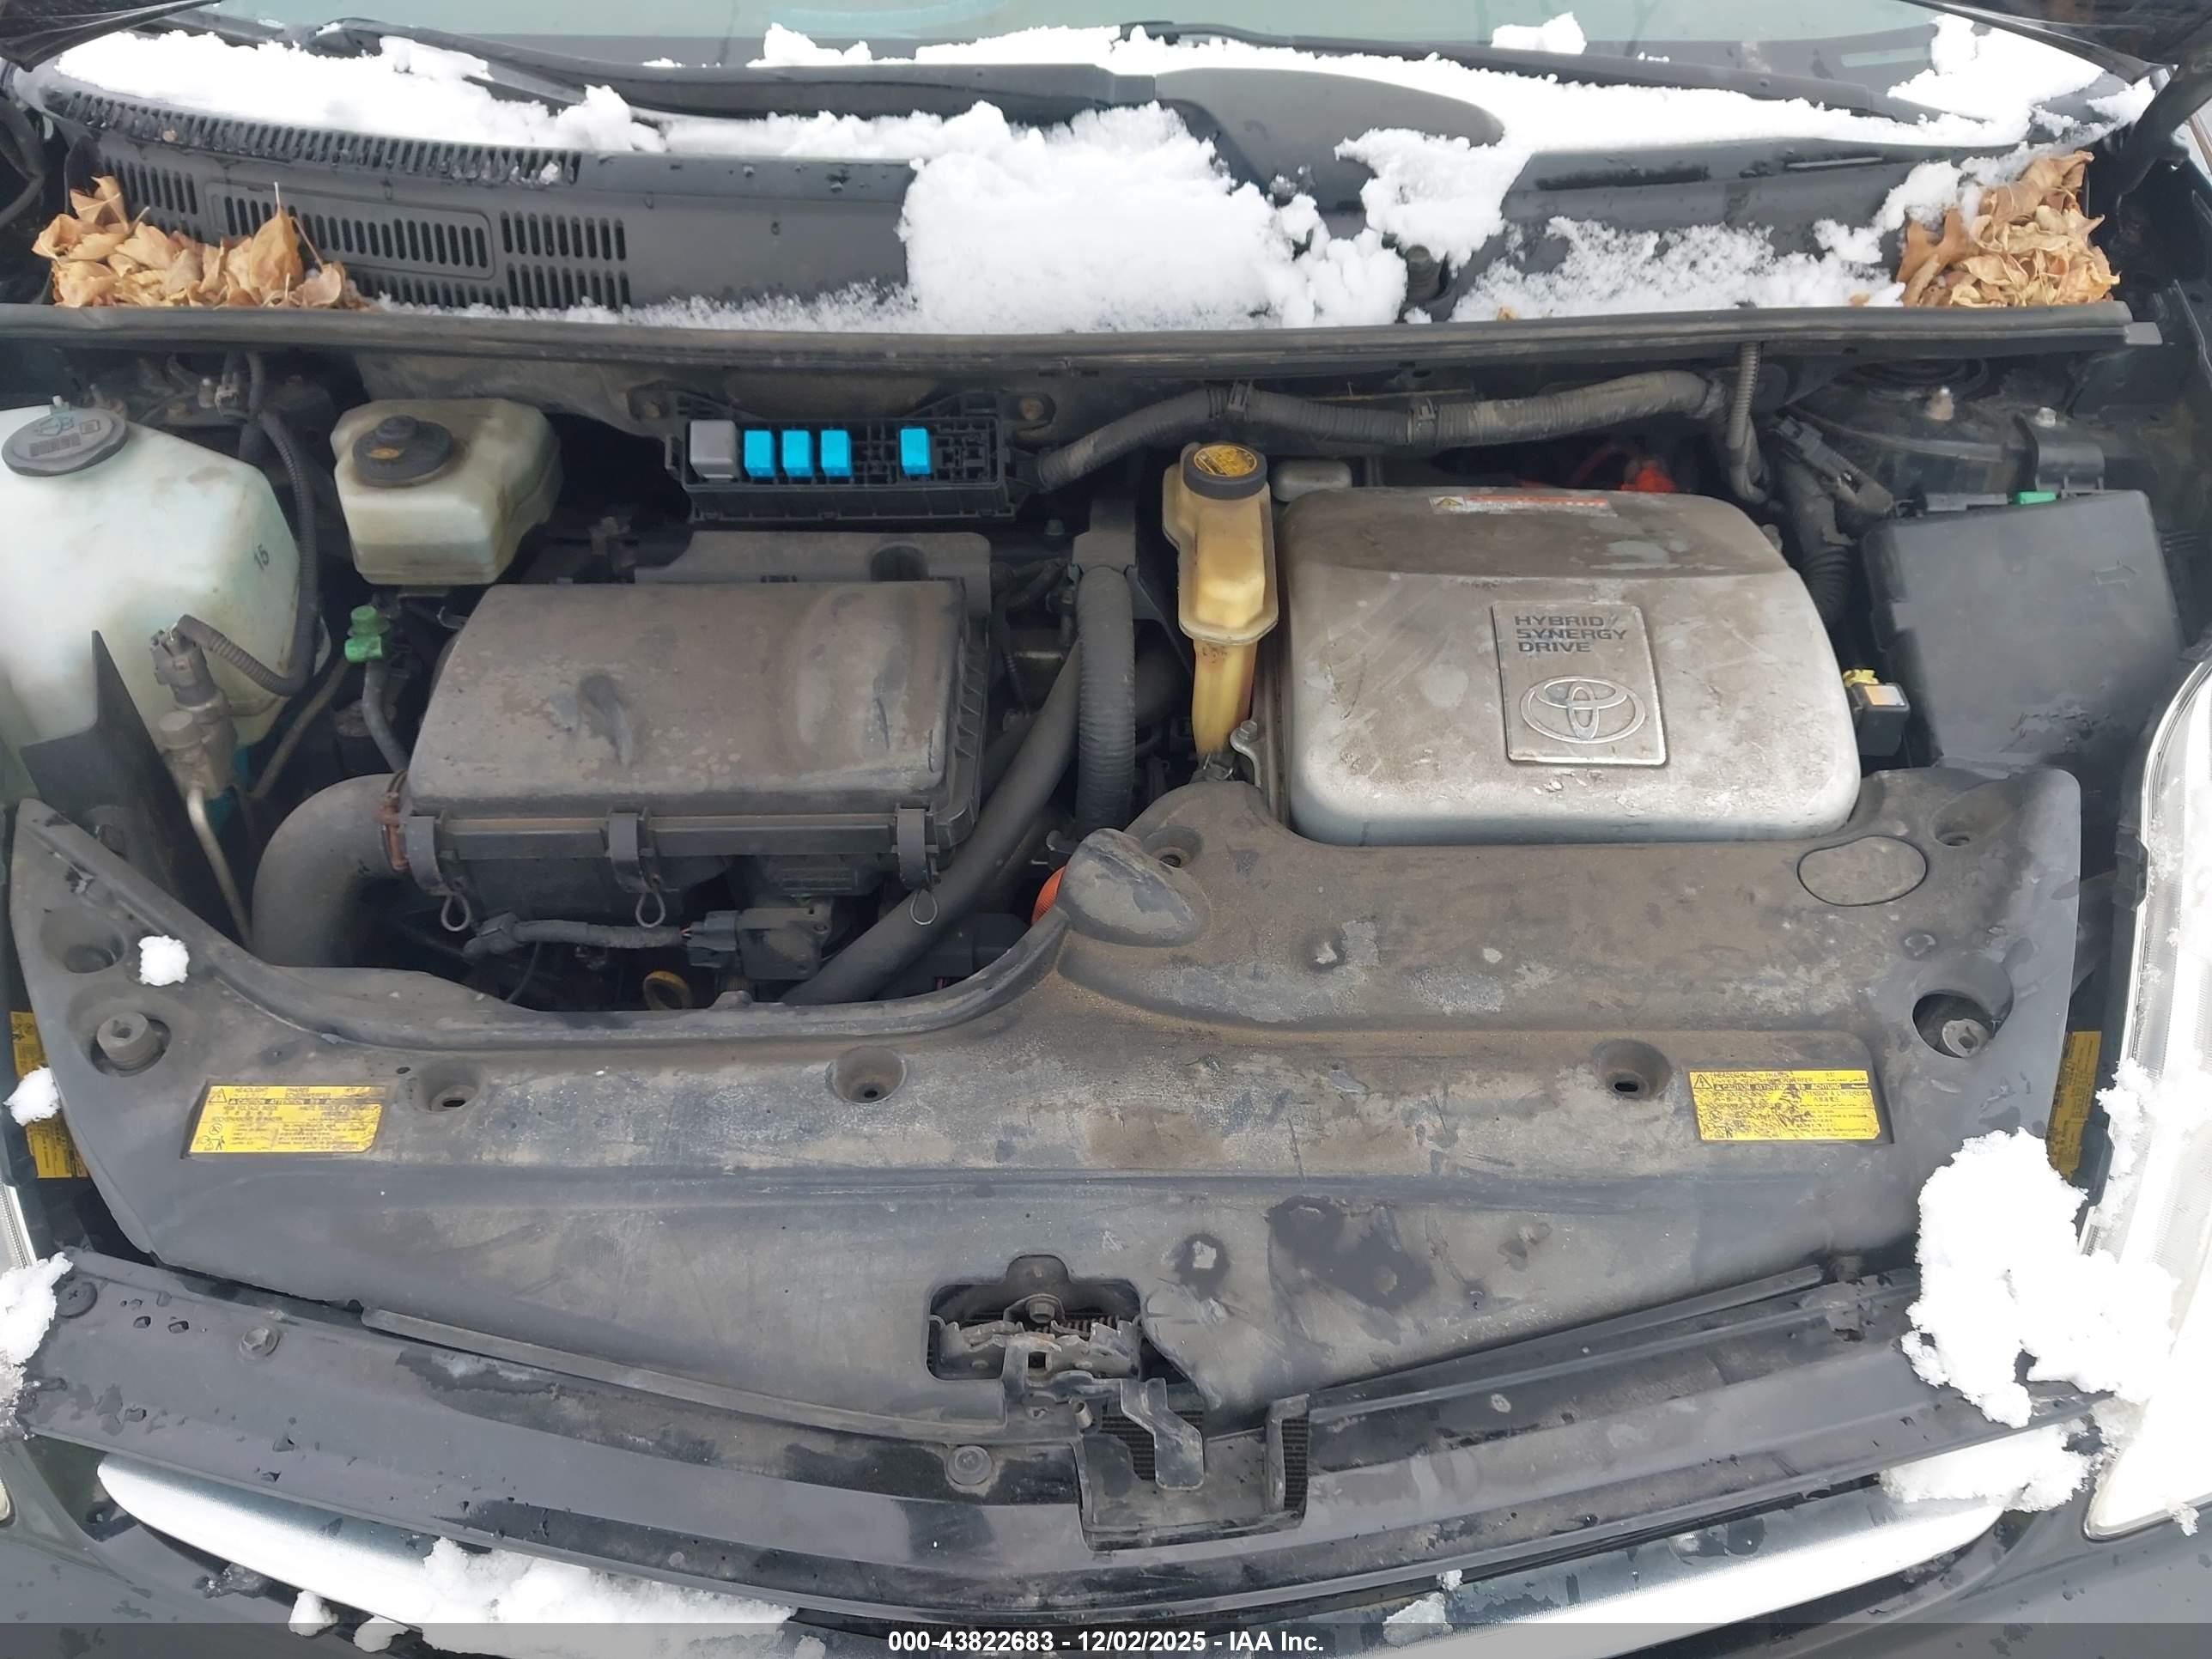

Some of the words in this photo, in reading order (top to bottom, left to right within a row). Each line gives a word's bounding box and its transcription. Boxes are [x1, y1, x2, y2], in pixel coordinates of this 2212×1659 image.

[1515, 615, 1605, 627] HYBRID
[1516, 629, 1628, 640] SYNERGY
[1518, 641, 1592, 653] DRIVE
